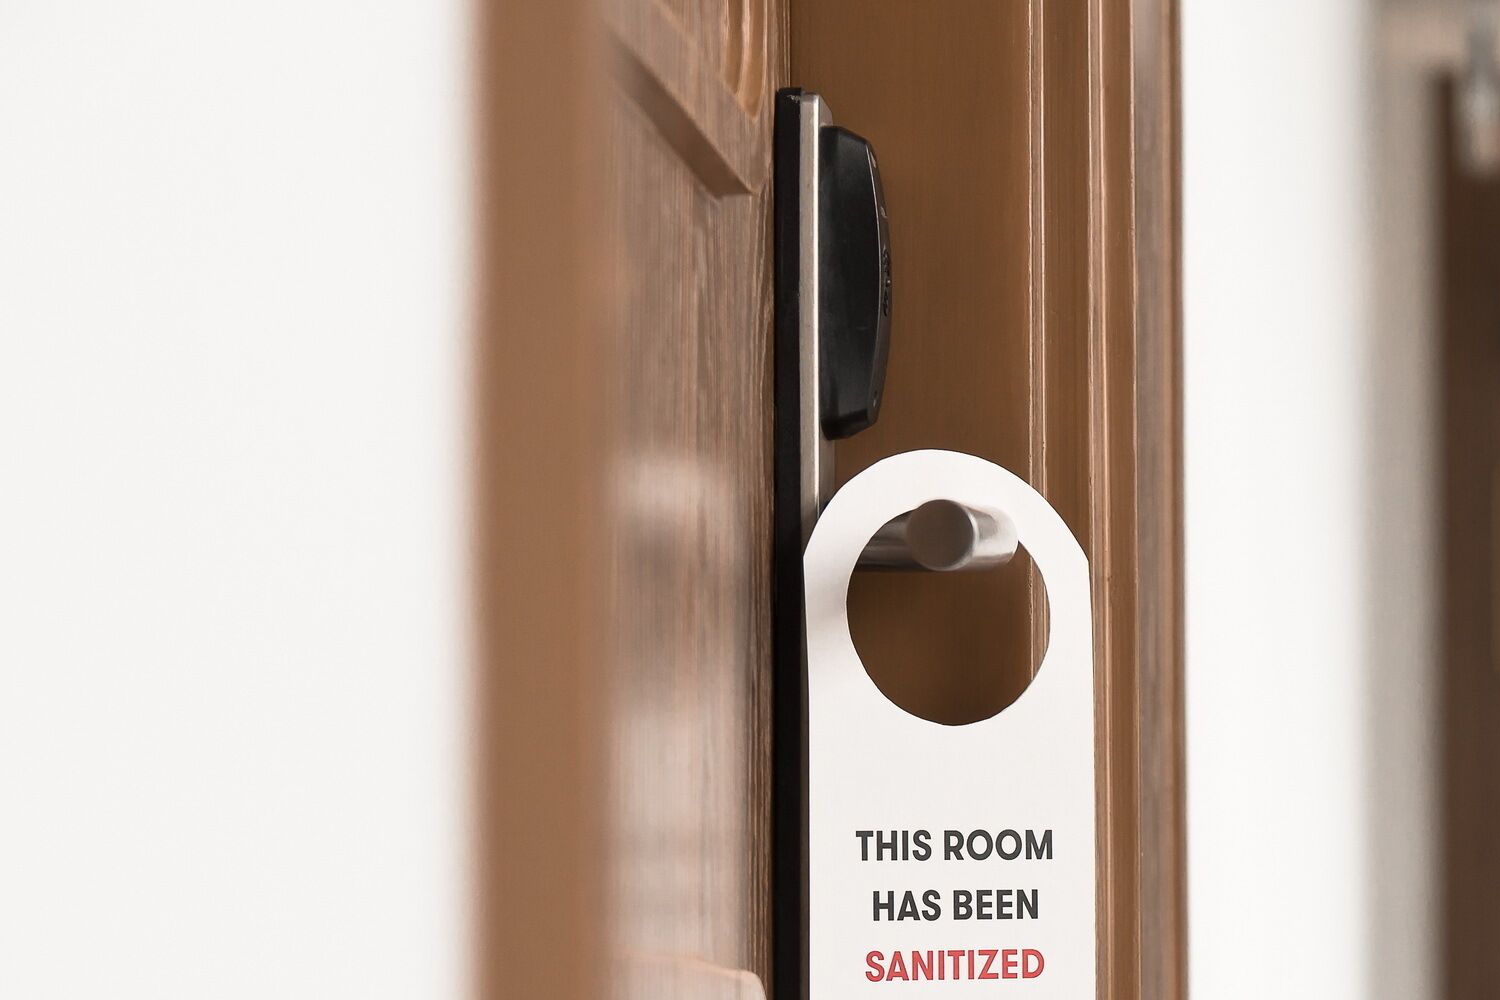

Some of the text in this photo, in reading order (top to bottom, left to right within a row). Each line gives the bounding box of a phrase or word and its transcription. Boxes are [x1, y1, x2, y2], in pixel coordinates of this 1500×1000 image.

[856, 829, 1053, 861] THIS ROOM
[873, 889, 1039, 922] HAS BEEN
[865, 949, 1045, 982] SANITIZED
